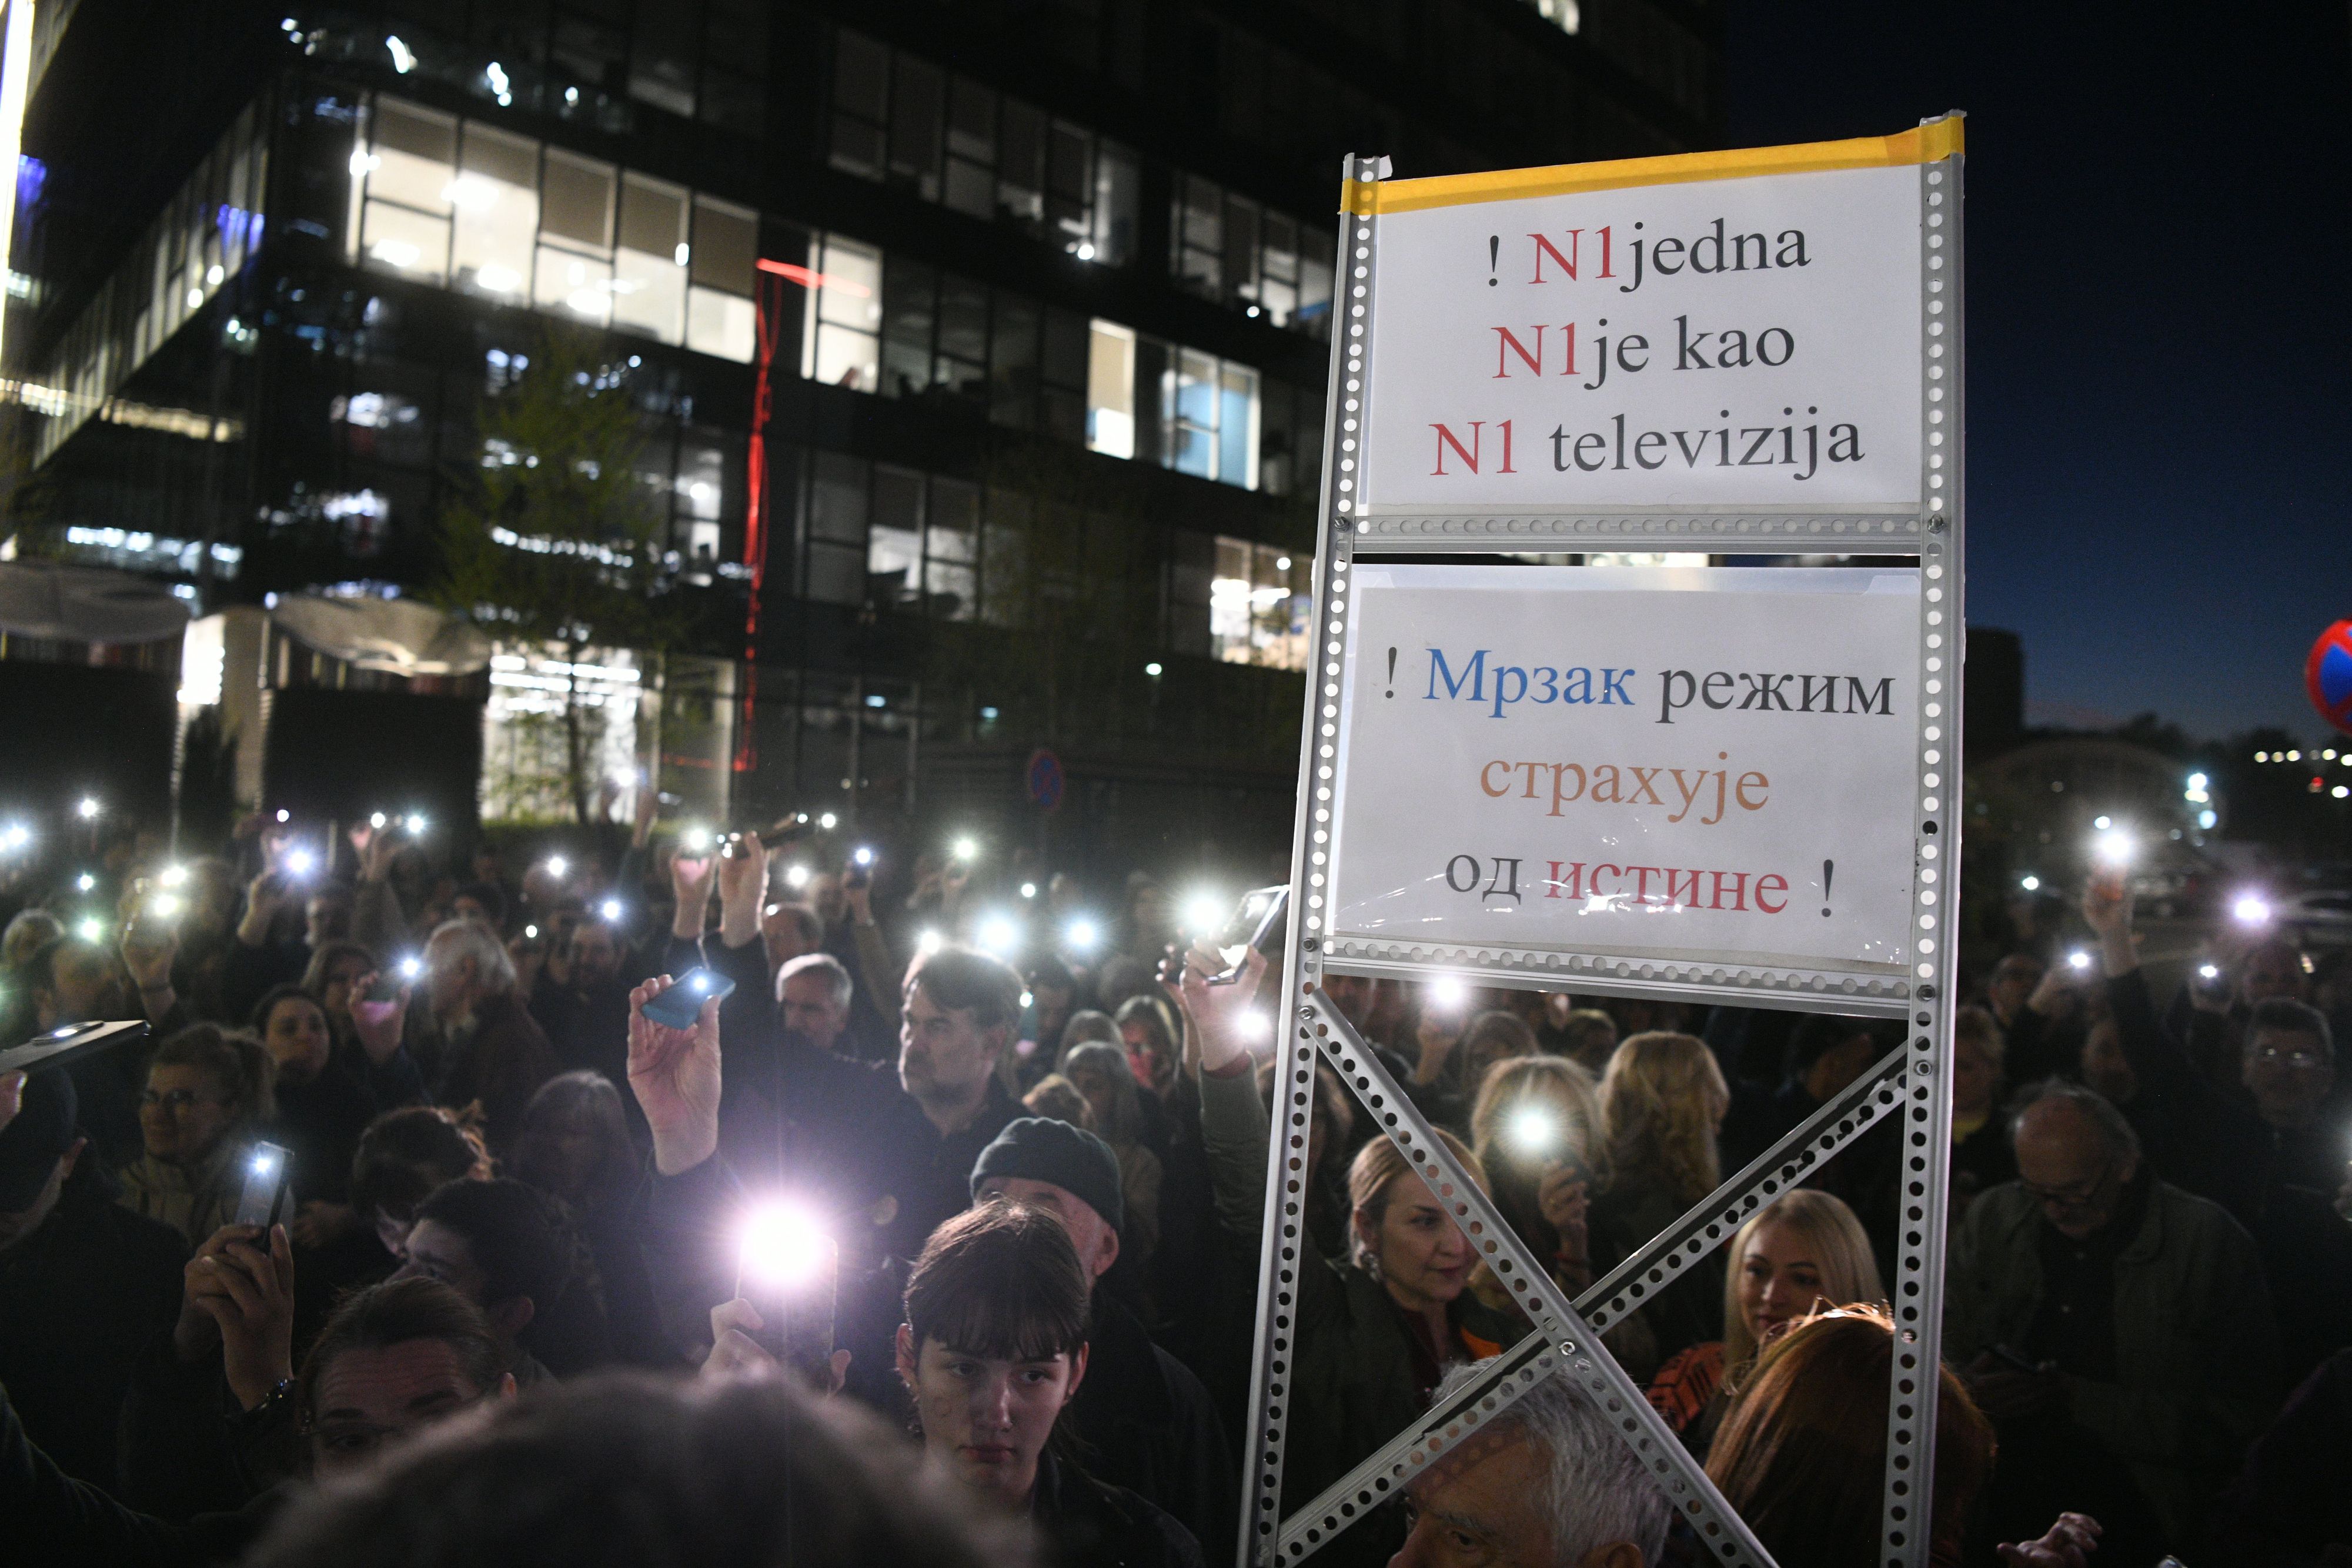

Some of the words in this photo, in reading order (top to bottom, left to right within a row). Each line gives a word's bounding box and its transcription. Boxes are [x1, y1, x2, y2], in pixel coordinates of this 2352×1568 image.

[1488, 235, 1499, 287] !
[1491, 318, 1649, 390] N1je
[1673, 315, 1795, 370] kao
[1428, 419, 1517, 476] N1
[1549, 406, 1866, 481] televizija
[1385, 647, 1397, 699] !
[1422, 648, 1636, 718] Мрзак
[1655, 670, 1896, 724] режим
[1481, 751, 1769, 825] страхује
[1445, 854, 1524, 905] од
[1544, 861, 1789, 914] истине
[1821, 859, 1835, 918] !
